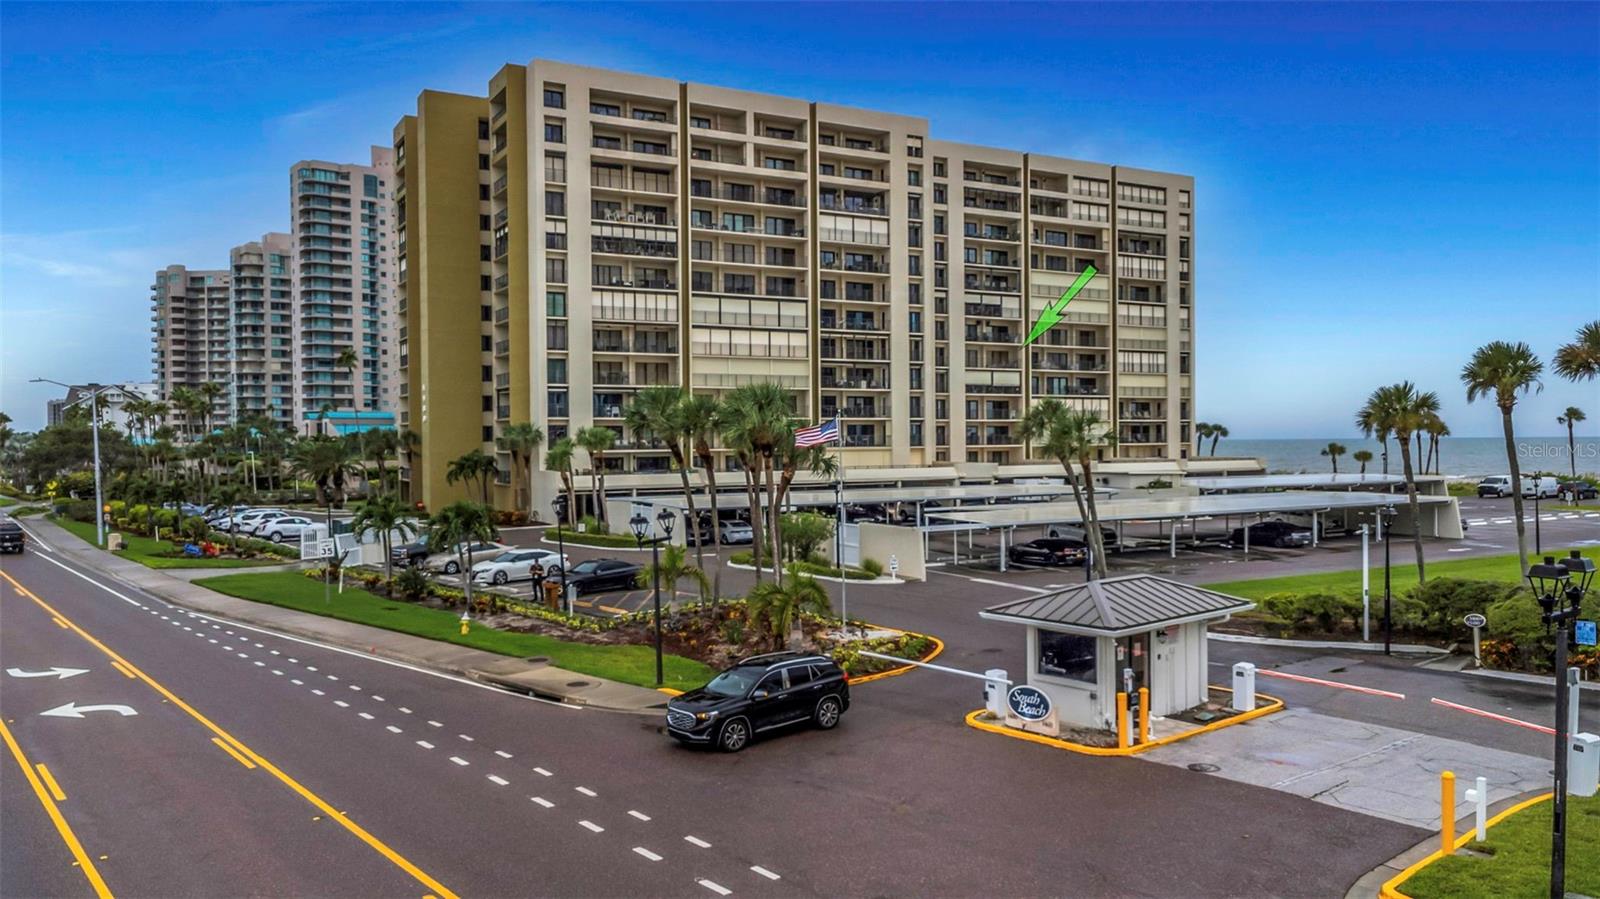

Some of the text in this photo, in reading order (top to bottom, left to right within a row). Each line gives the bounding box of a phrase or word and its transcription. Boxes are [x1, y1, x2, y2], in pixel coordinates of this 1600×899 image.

[321, 547, 333, 556] 35
[1012, 689, 1040, 705] South
[1018, 701, 1046, 716] Beach
